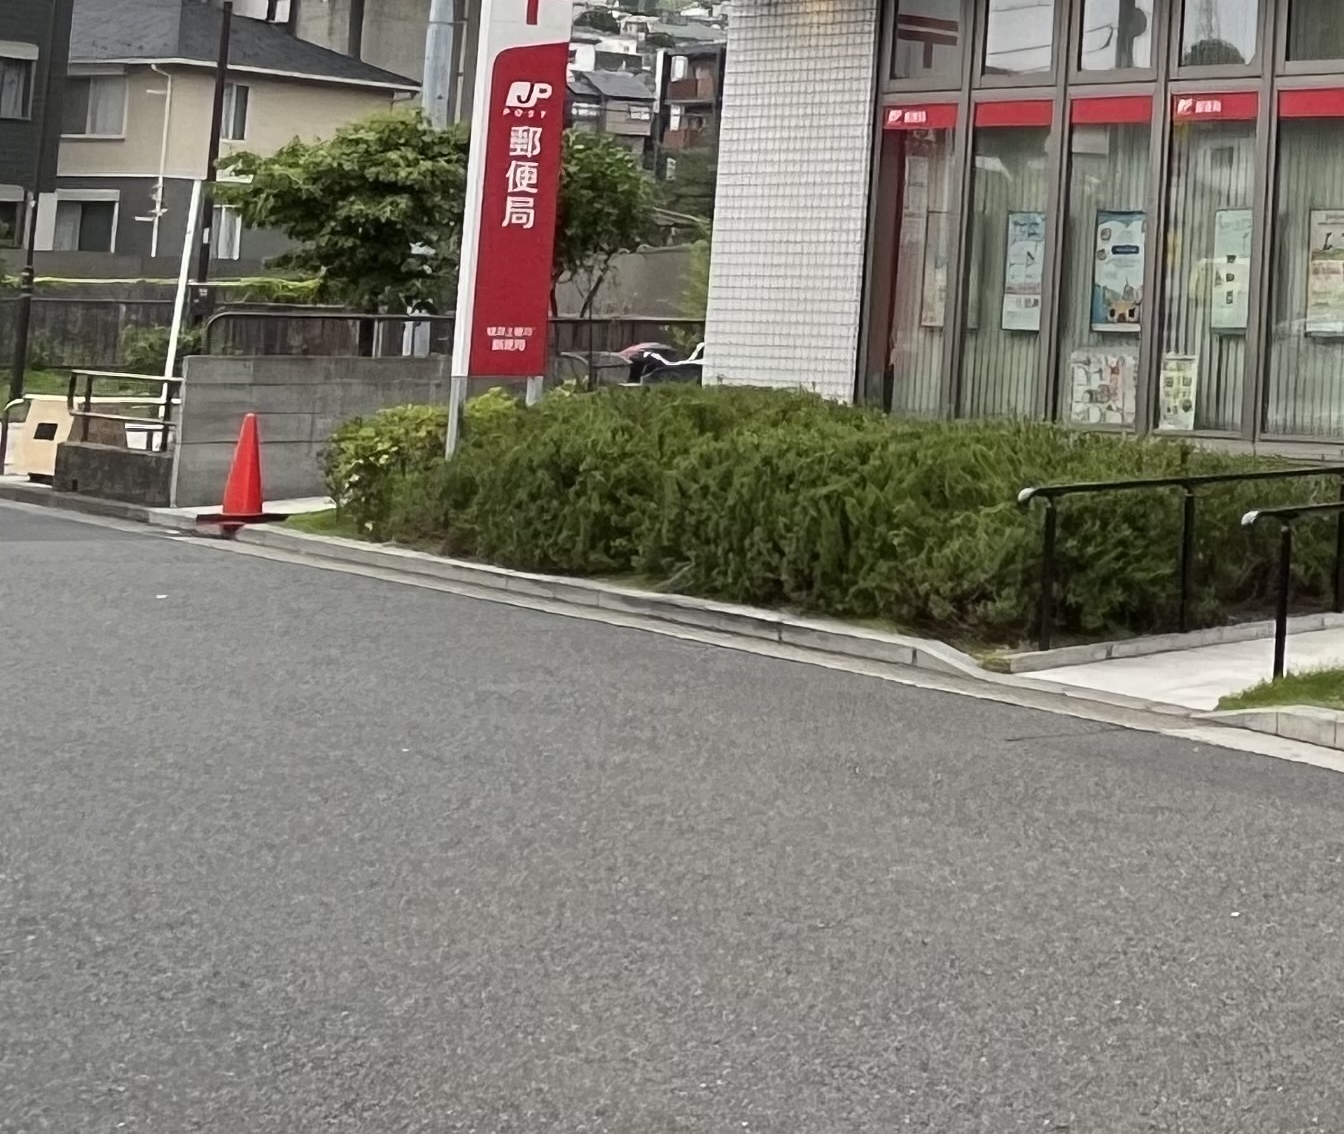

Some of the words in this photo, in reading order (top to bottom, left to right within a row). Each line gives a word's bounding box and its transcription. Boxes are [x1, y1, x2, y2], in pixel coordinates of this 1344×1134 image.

[505, 81, 553, 108] JP
[502, 125, 543, 229] 郵便局
